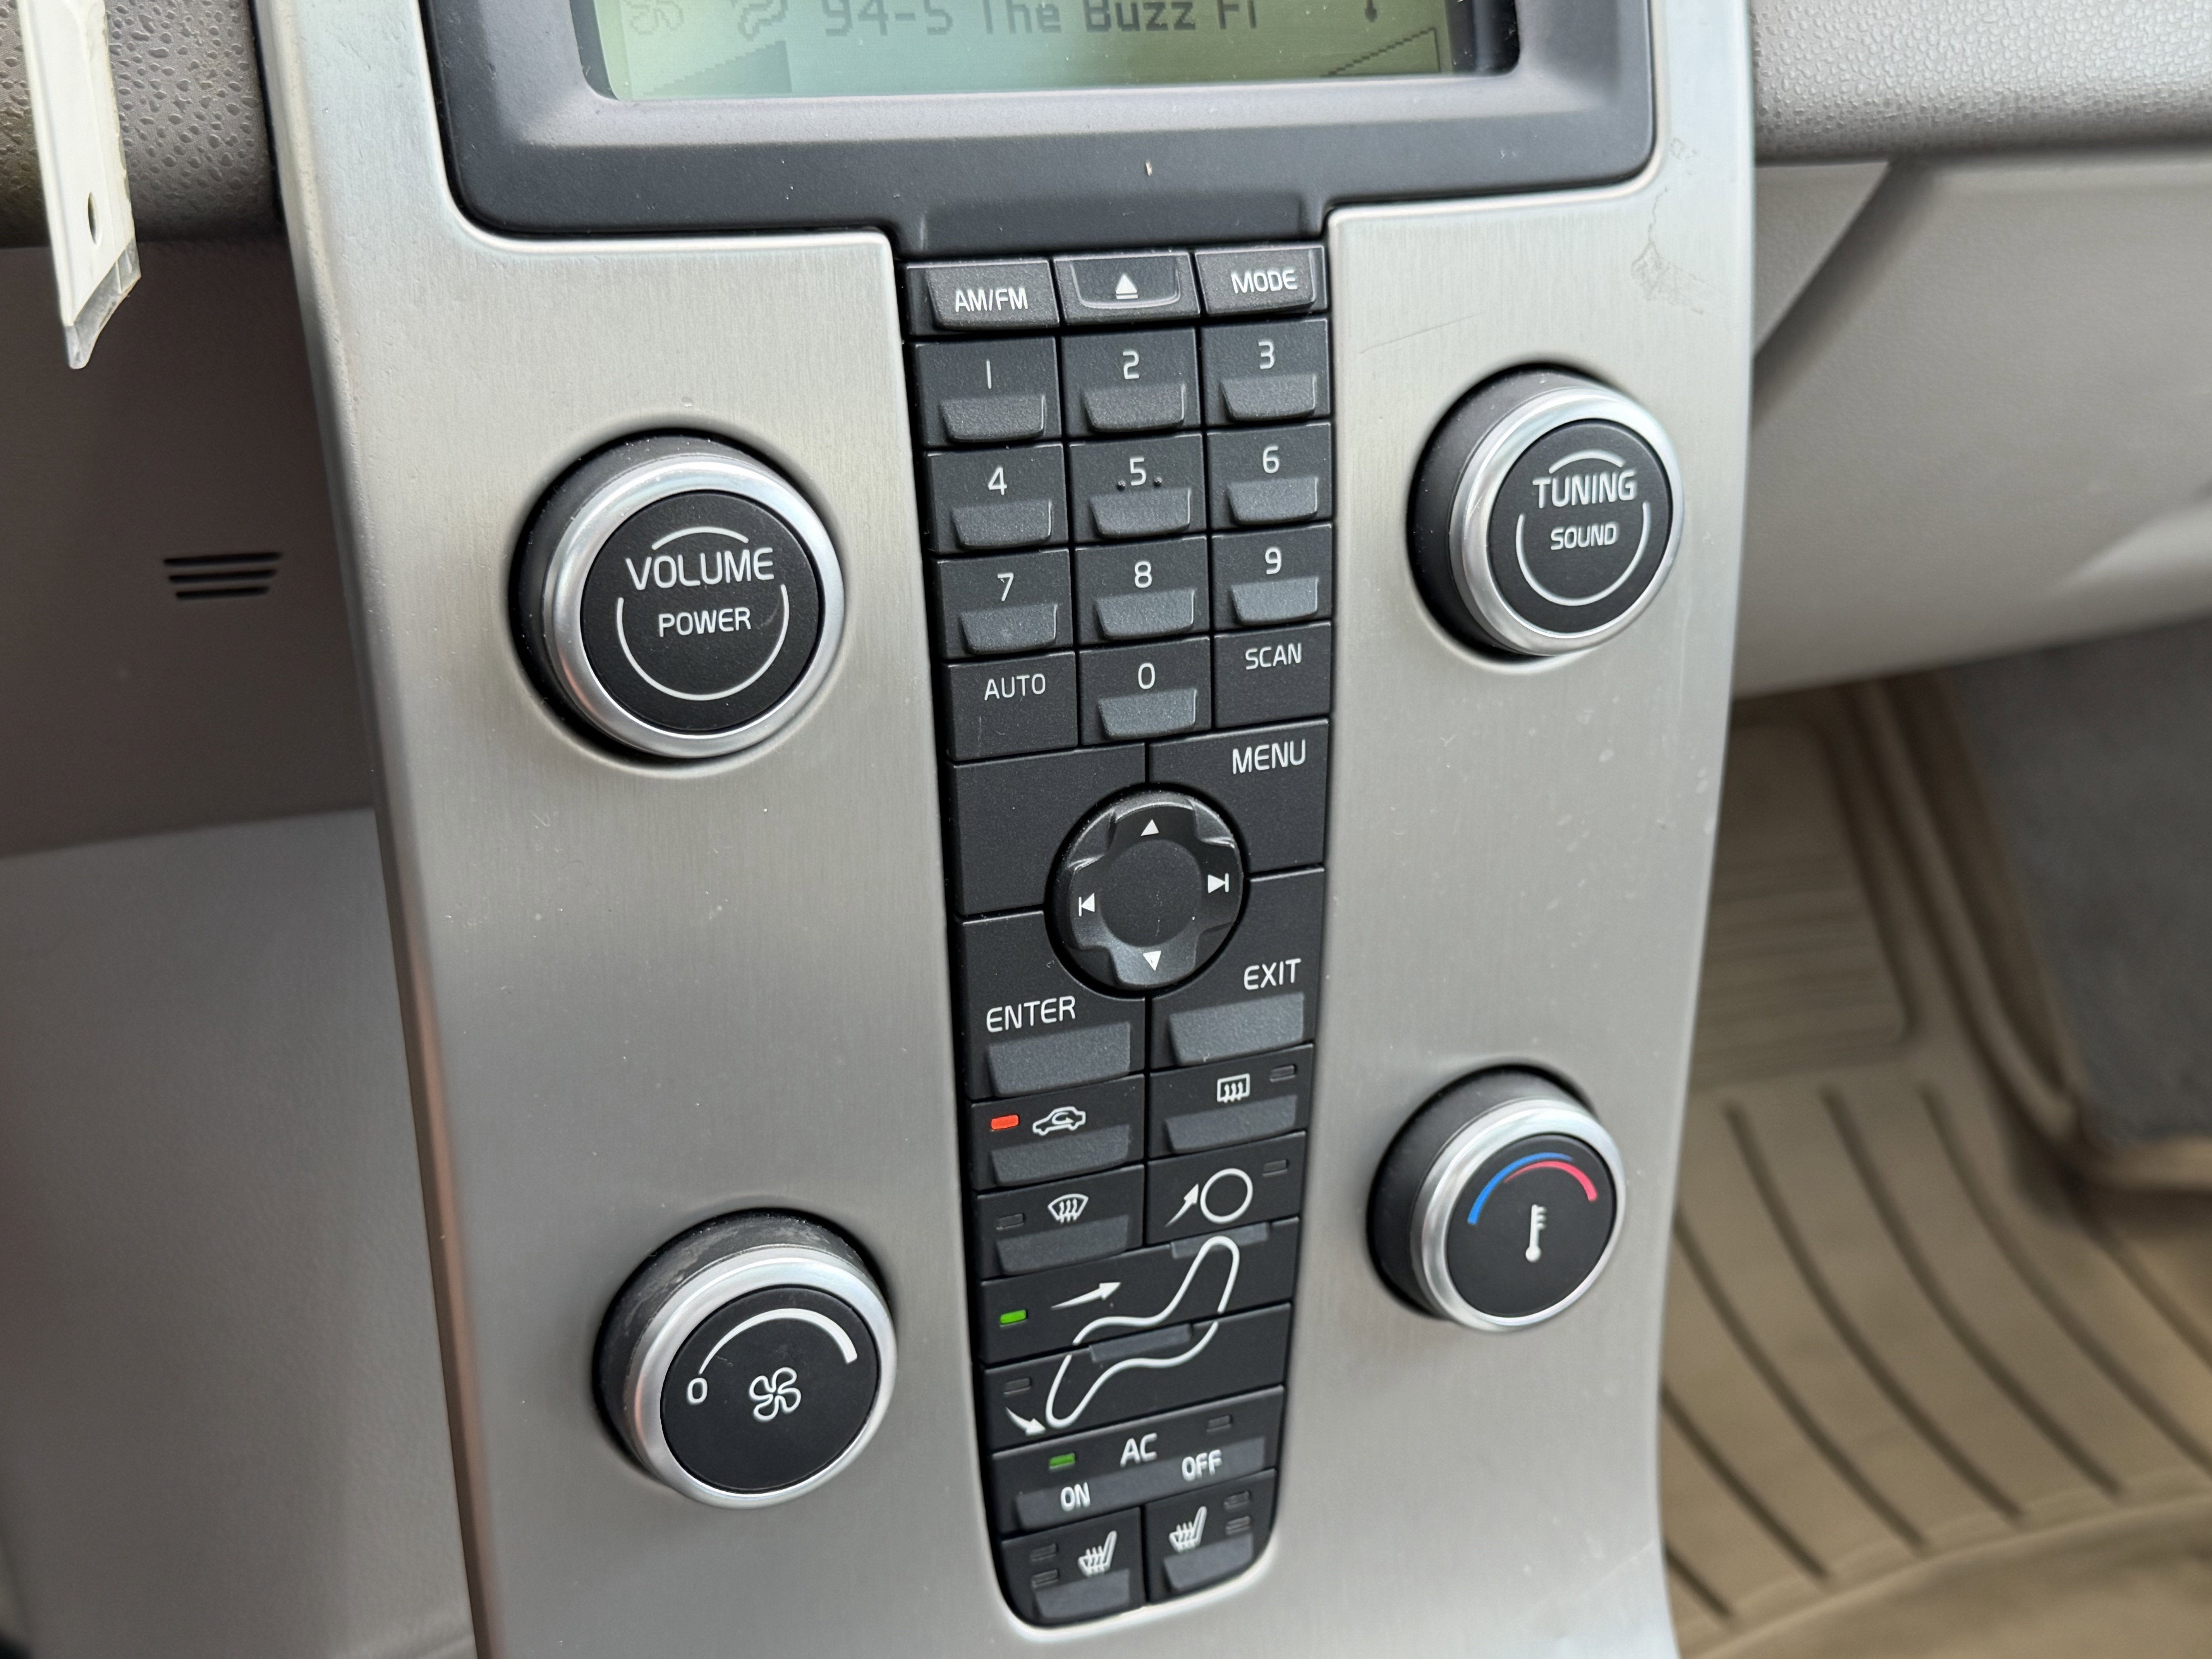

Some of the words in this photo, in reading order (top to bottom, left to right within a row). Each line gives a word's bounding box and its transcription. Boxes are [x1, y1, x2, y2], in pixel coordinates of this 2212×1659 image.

[1084, 0, 1197, 33] Buzz
[1230, 268, 1298, 294] MODE
[955, 285, 1029, 313] AM/FM
[1122, 350, 1140, 380] 2
[1258, 340, 1275, 369] 3
[986, 360, 992, 389] 1
[1129, 457, 1147, 486] 5
[1262, 445, 1280, 474] 6
[988, 466, 1008, 496] 4
[1532, 468, 1637, 509] TUNING
[1550, 522, 1618, 550] SOUND
[625, 546, 775, 591] VOLUME
[1134, 560, 1152, 589] 8
[1264, 546, 1282, 575] 9
[997, 572, 1014, 602] 7
[658, 606, 752, 638] POWER
[1245, 642, 1302, 670] SCAN
[984, 673, 1046, 701] AUTO
[1137, 662, 1156, 690] 0
[1232, 739, 1306, 775] MENU
[1243, 958, 1302, 990] EXIT
[986, 995, 1076, 1033] ENTER
[1120, 1432, 1157, 1465] AC
[1181, 1449, 1222, 1481] OFF
[1060, 1482, 1091, 1511] ON
